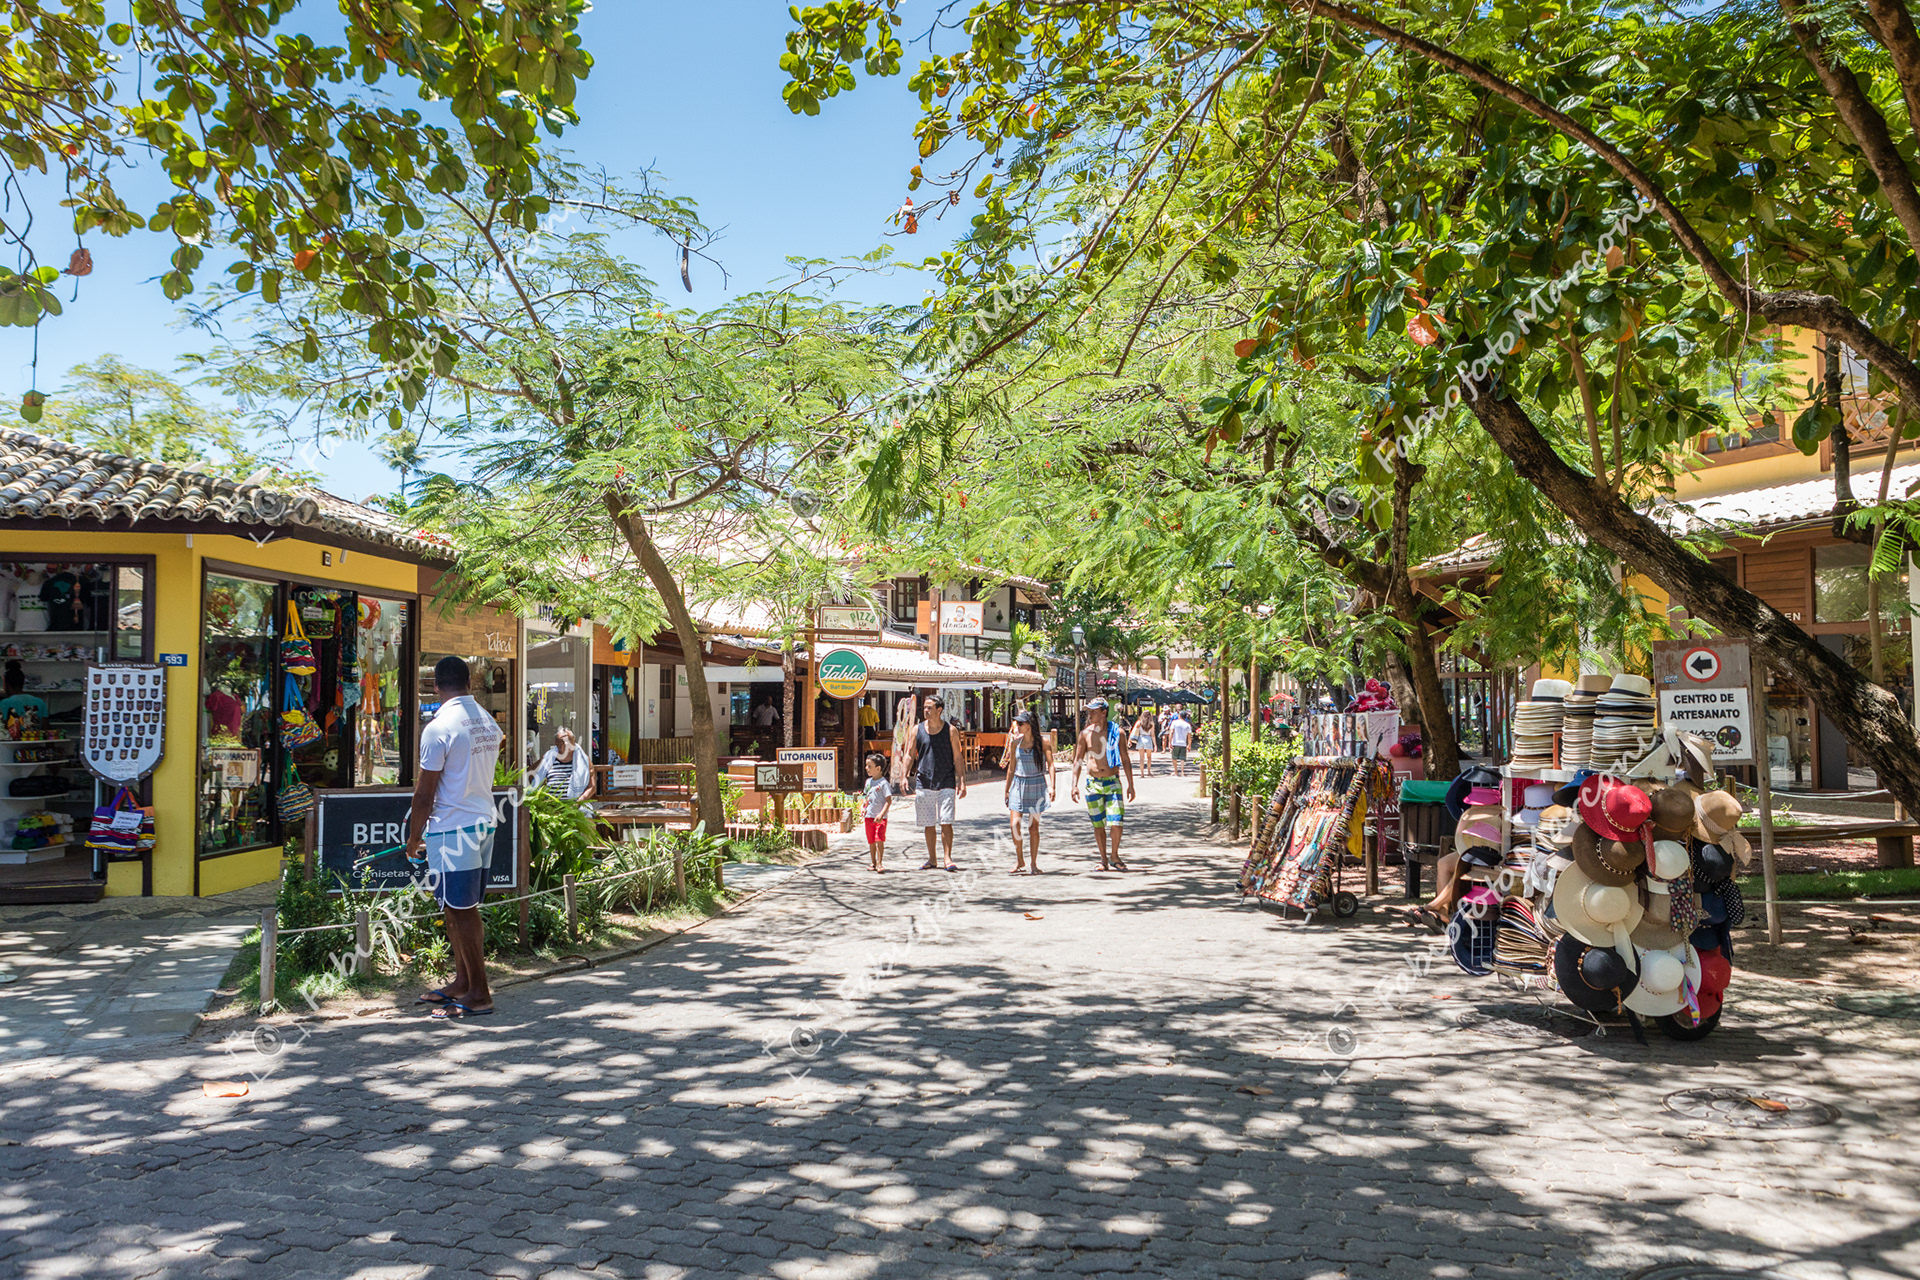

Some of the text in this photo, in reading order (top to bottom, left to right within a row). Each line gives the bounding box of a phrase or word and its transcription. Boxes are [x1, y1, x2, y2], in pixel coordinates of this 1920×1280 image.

[165, 656, 183, 664] 593
[1674, 693, 1734, 704] CENTRO DE
[1670, 709, 1740, 720] ARTESANATO
[780, 753, 834, 761] LITORANEUS
